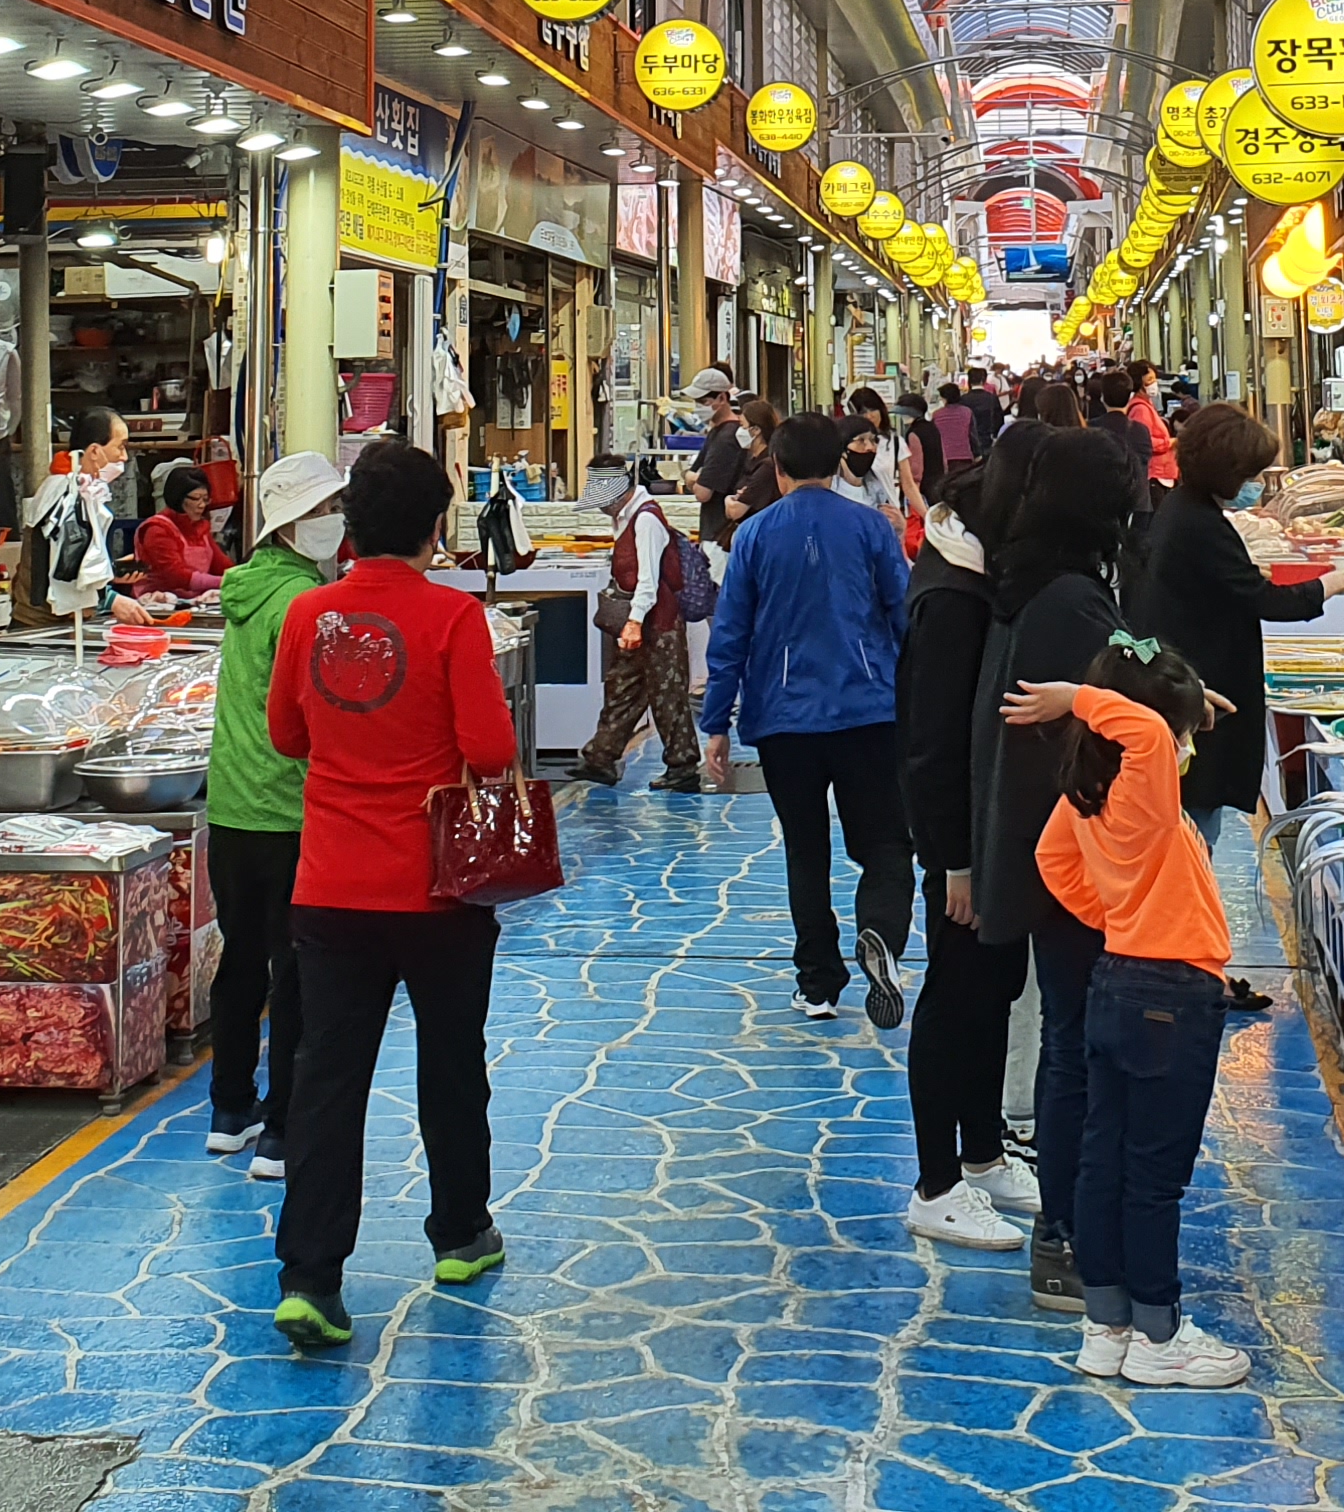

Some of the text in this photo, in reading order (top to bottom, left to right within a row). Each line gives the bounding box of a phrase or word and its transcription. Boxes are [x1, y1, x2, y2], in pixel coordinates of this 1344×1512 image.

[641, 54, 720, 74] 두부마당
[653, 87, 706, 96] 636-6331
[1166, 106, 1196, 121] 명초
[376, 92, 420, 156] 산횟집
[1252, 171, 1330, 185] 632-4071
[824, 182, 871, 195] 카페그린
